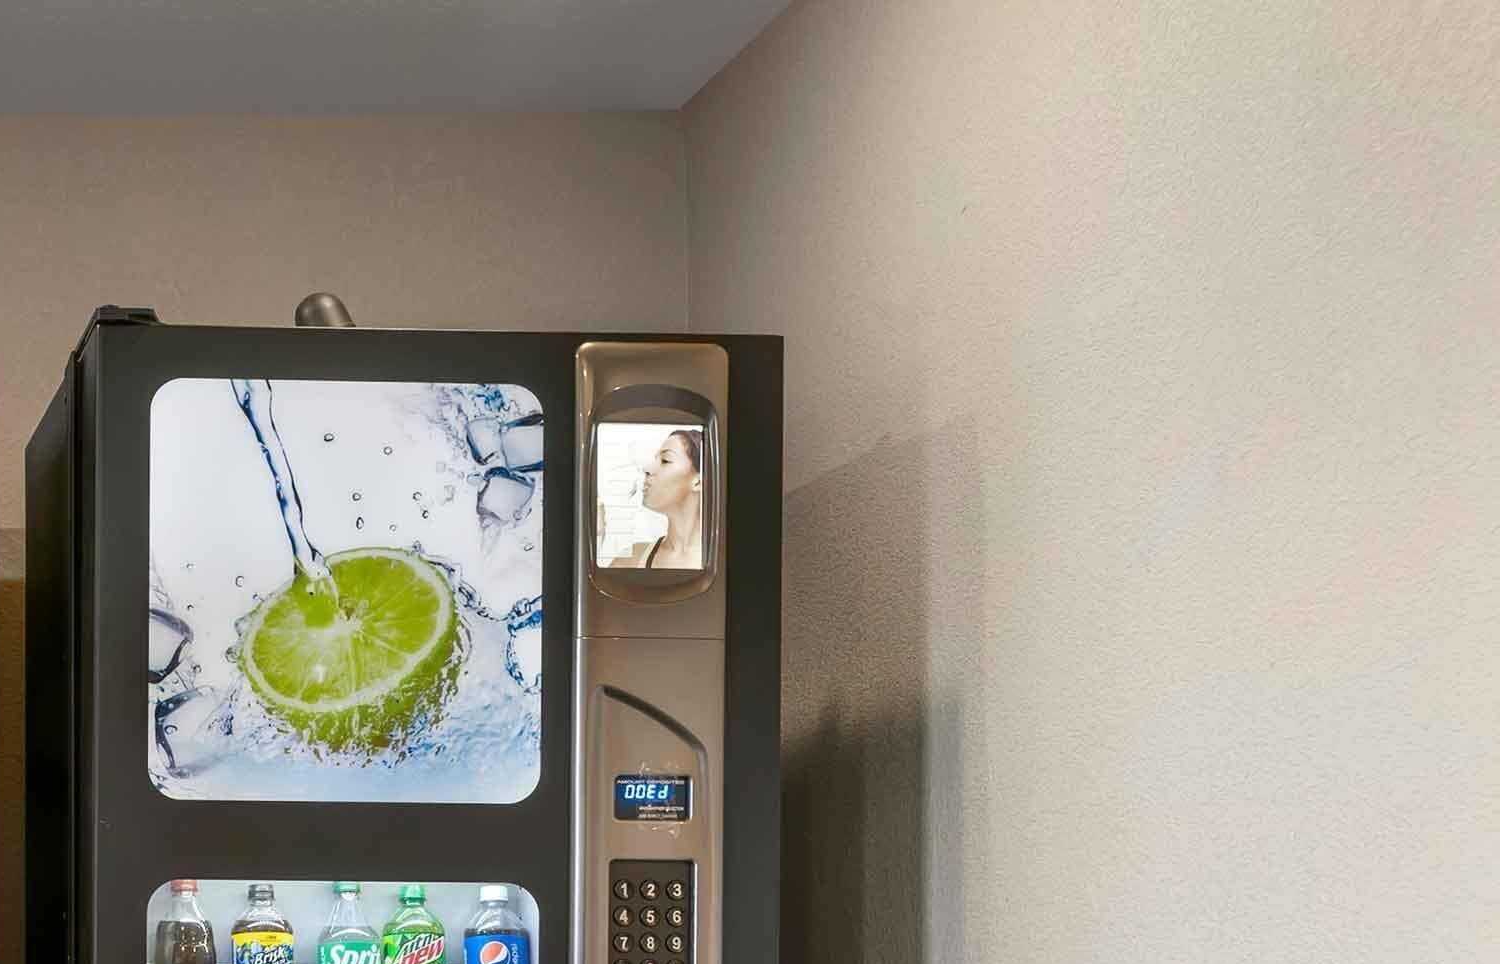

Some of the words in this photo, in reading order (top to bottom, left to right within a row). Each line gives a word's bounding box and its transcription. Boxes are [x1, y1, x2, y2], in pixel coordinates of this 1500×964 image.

[620, 883, 629, 897] 1
[646, 883, 655, 897] 2
[673, 883, 682, 897] 3
[620, 910, 629, 924] 4
[646, 910, 655, 924] 5
[673, 910, 682, 924] 6
[620, 936, 629, 950] 7
[646, 936, 655, 950] 8
[673, 936, 682, 950] 9
